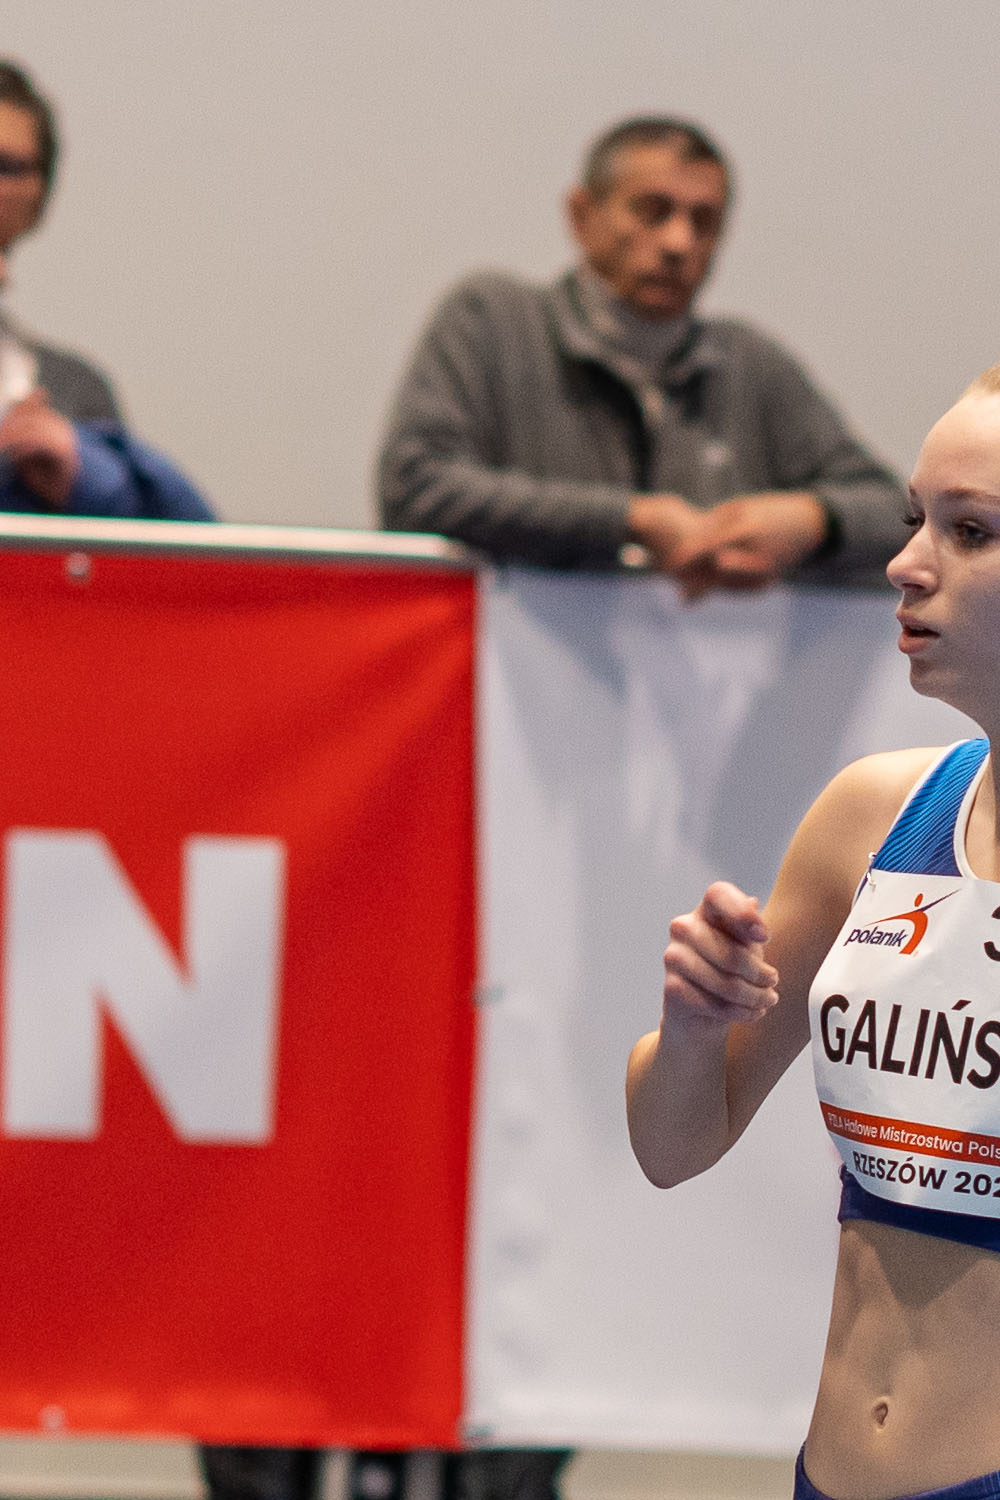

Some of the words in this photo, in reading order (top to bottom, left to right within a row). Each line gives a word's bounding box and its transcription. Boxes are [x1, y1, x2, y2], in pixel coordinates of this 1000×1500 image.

[843, 926, 908, 947] polanik
[3, 829, 285, 1145] N
[844, 1117, 878, 1138] Halowe
[879, 1125, 963, 1153] Mistrzostwa
[853, 1151, 947, 1190] RZESZÓW
